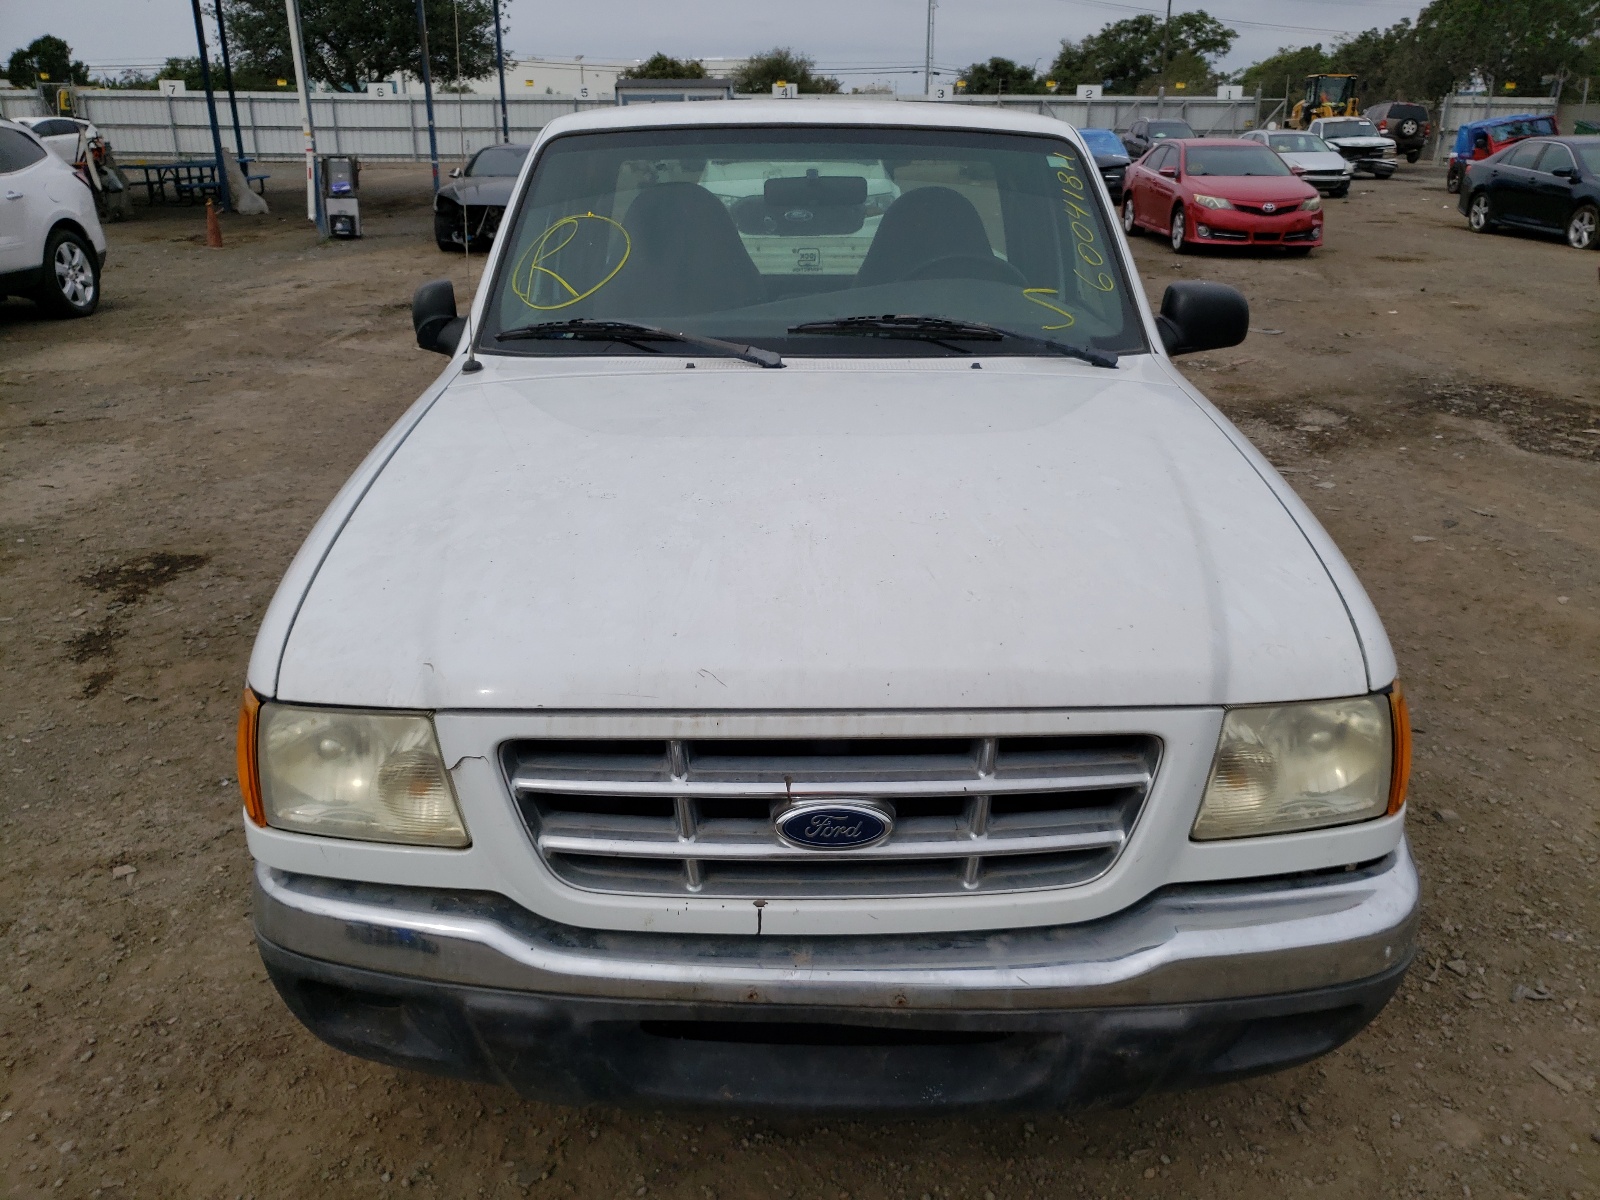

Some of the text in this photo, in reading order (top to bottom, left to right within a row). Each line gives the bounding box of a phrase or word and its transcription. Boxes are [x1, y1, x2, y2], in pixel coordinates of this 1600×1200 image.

[169, 85, 176, 94] 7
[377, 87, 384, 97] 6
[581, 87, 588, 97] 5
[937, 89, 944, 98] 3
[1085, 89, 1093, 98] 2
[804, 814, 862, 838] Ford
